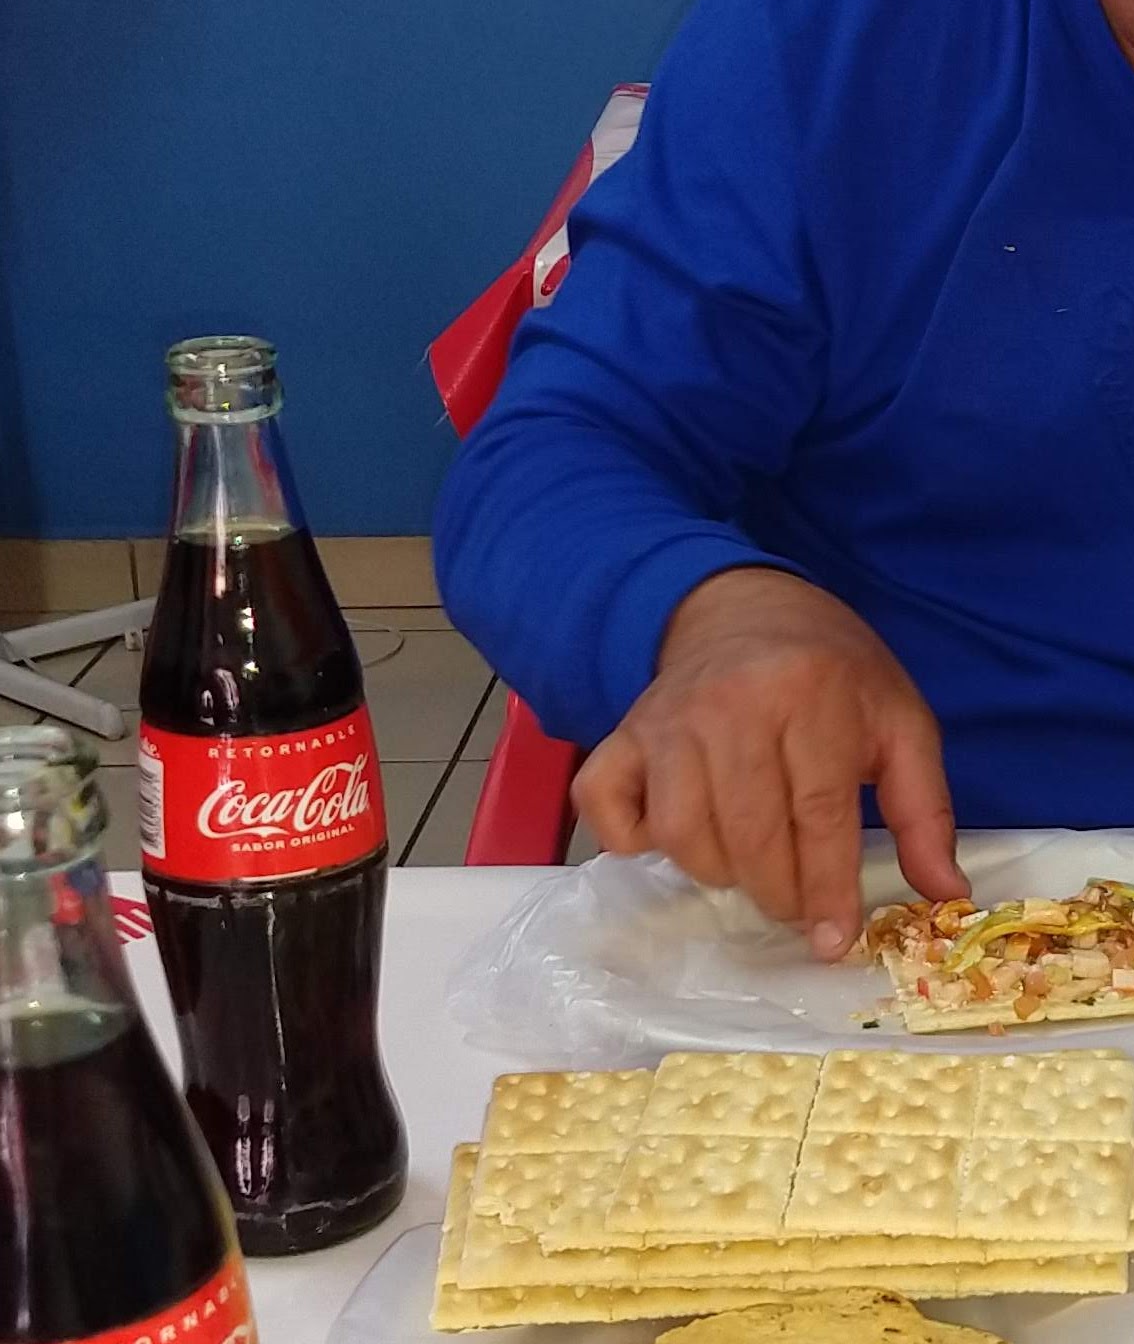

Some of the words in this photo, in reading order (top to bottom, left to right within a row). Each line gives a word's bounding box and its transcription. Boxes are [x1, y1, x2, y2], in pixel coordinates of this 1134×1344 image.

[207, 724, 357, 759] RETORNABLE
[197, 751, 370, 840] Coca-Cola
[230, 839, 286, 853] SABOR
[290, 823, 356, 848] ORIGINAL
